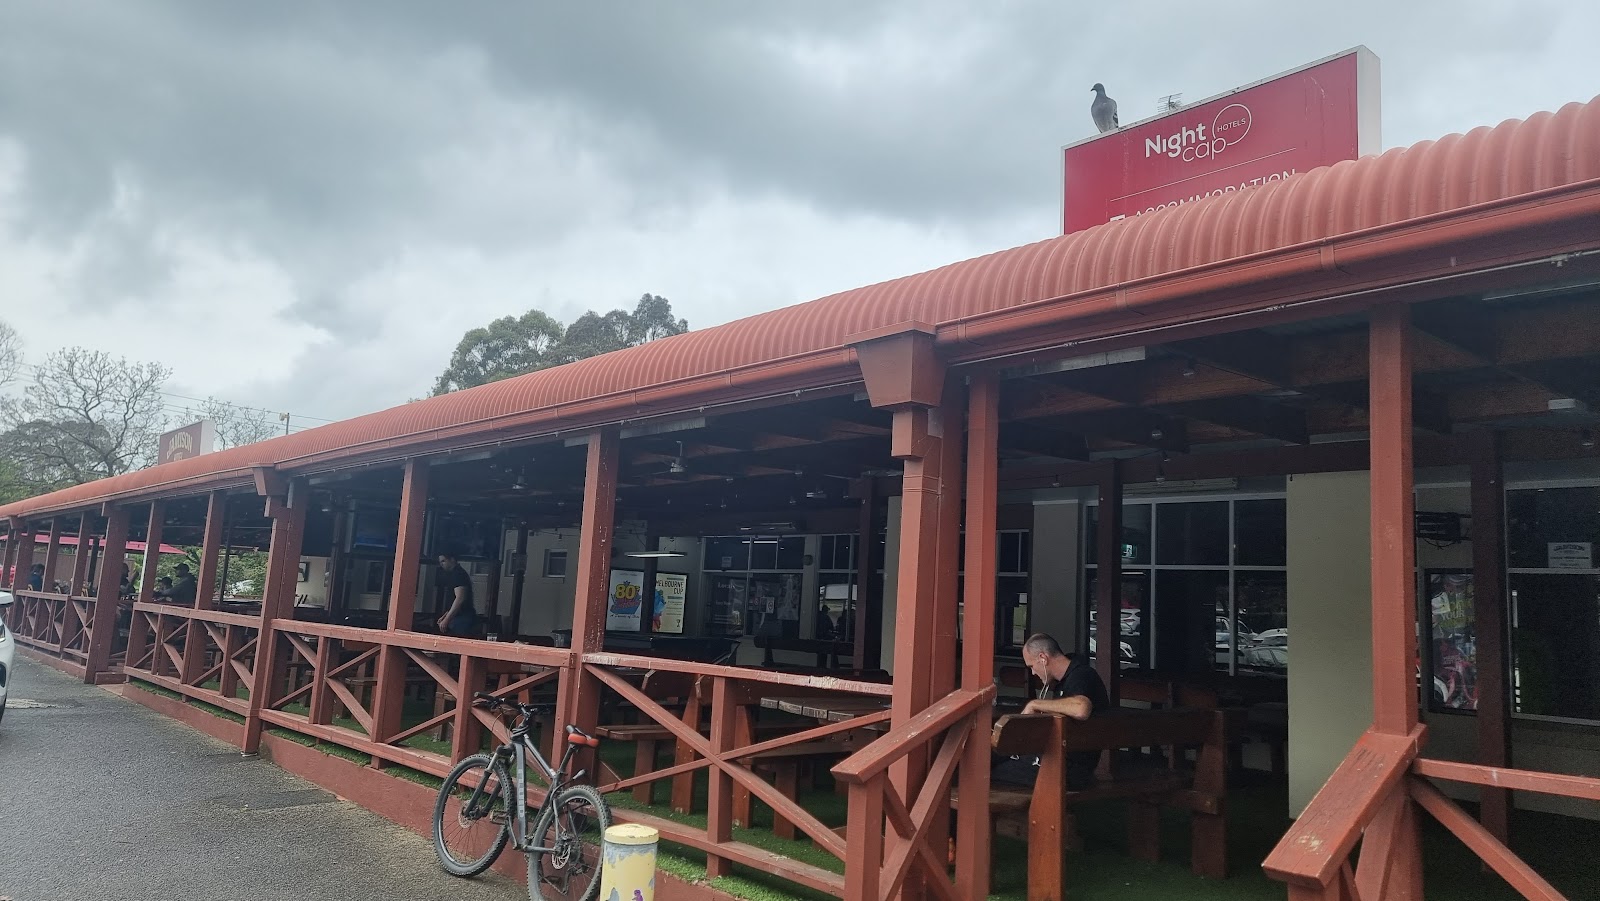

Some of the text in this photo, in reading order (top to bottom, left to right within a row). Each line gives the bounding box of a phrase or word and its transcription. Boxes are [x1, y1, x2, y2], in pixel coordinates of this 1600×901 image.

[1217, 118, 1246, 133] HOTELS
[1145, 123, 1206, 158] Night
[1182, 137, 1227, 162] cap
[656, 579, 684, 589] MELBOURNE
[673, 587, 684, 595] CUP
